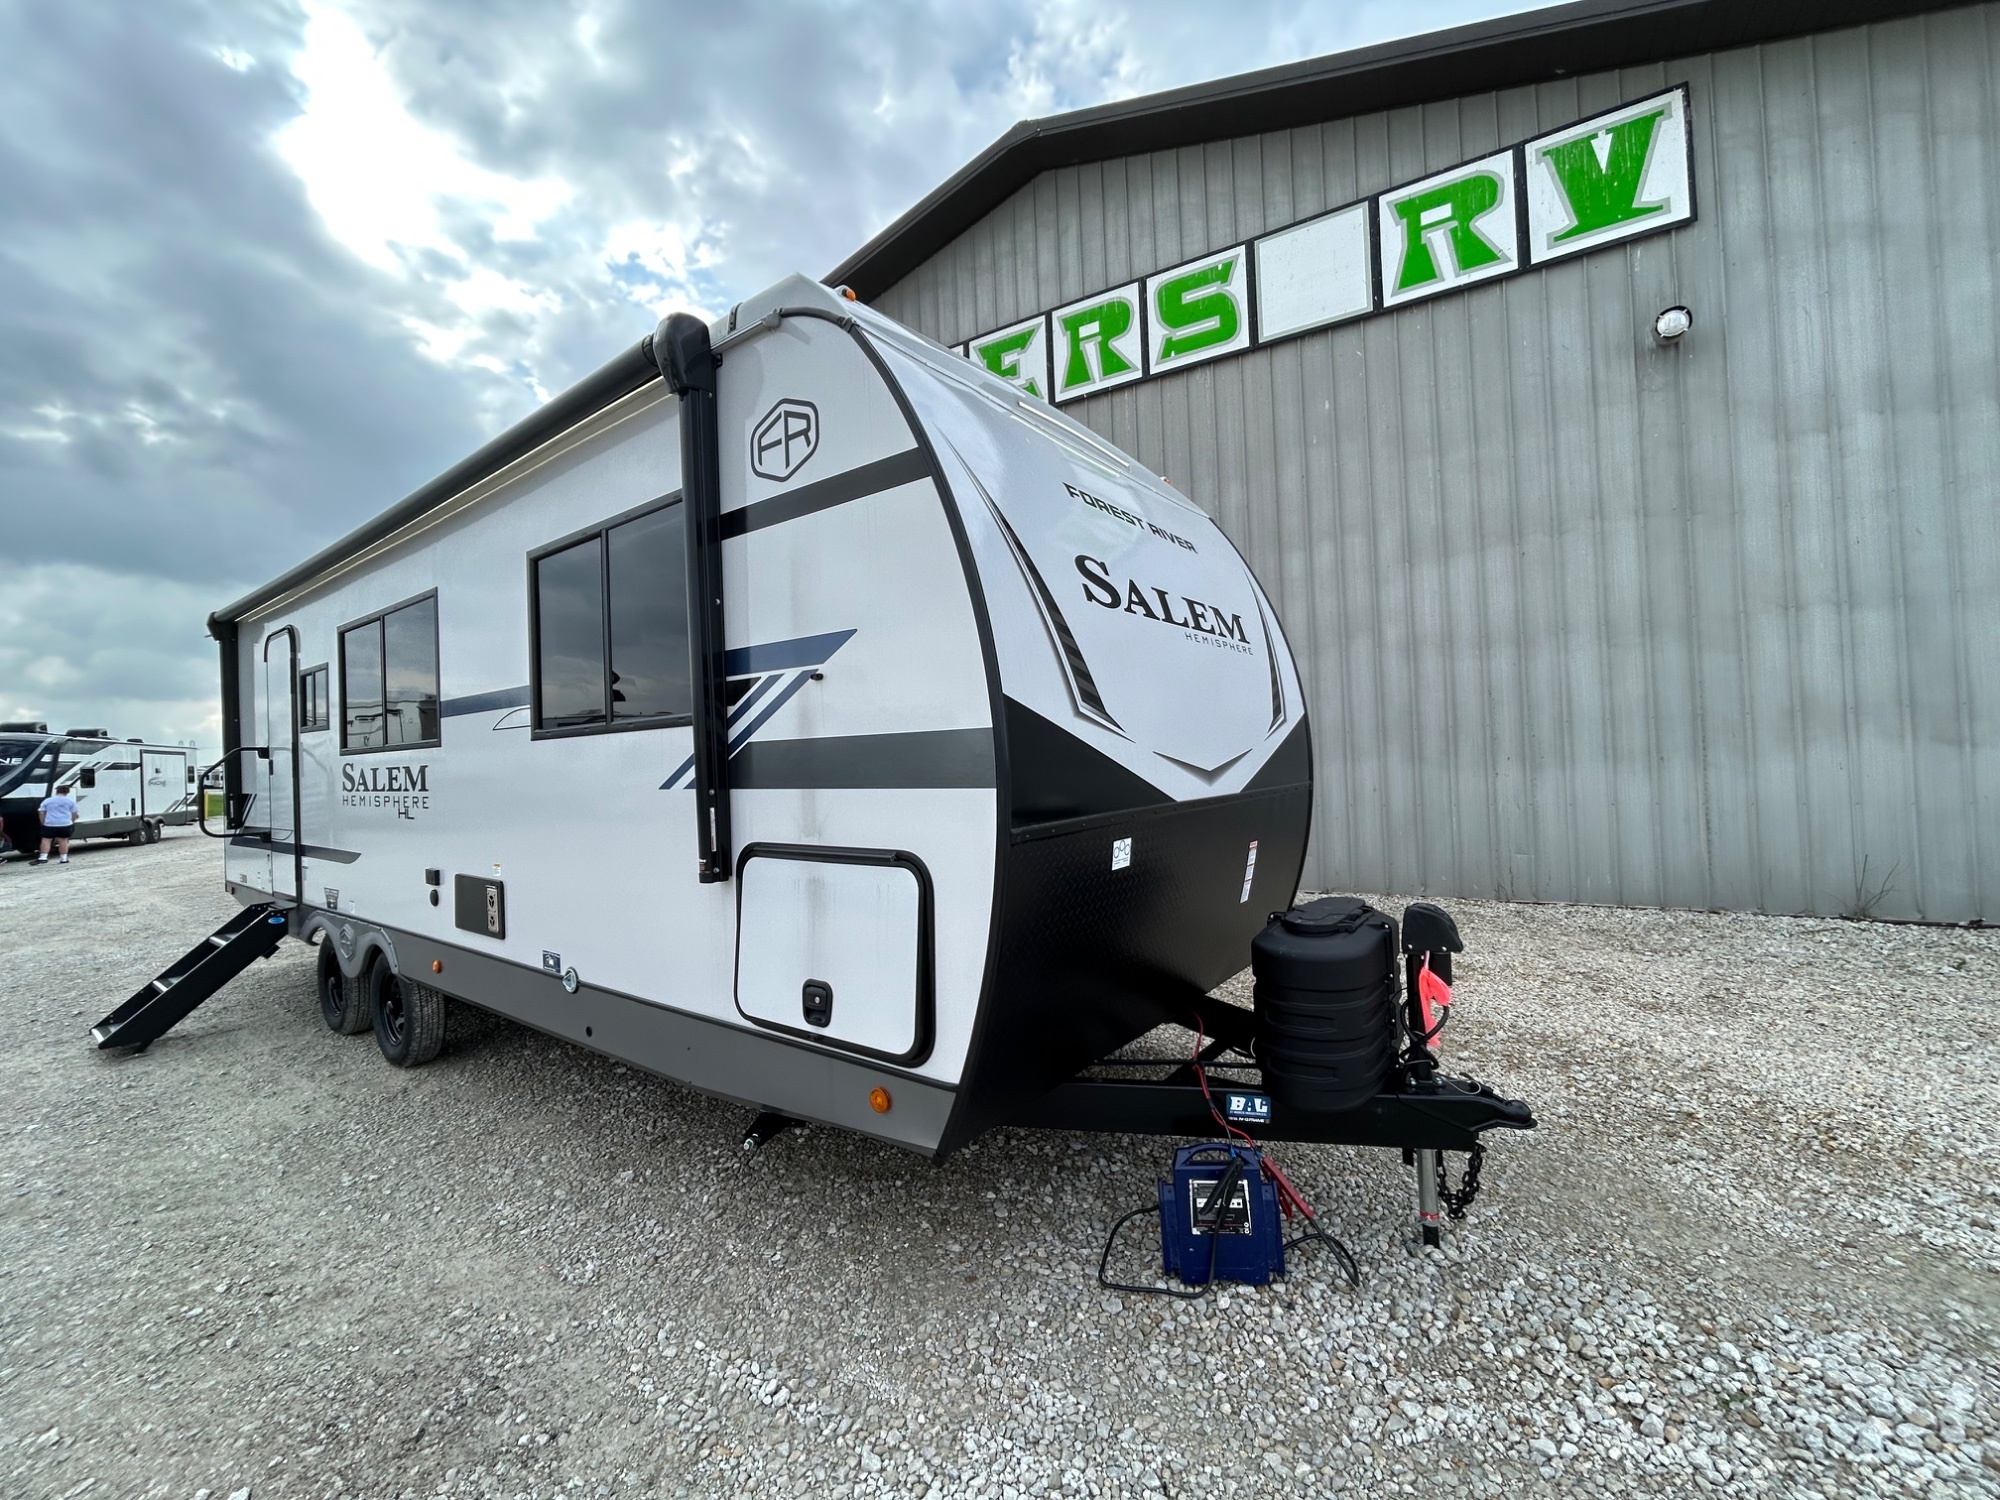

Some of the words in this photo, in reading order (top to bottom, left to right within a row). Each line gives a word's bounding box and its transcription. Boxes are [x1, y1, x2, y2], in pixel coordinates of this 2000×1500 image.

[1390, 101, 1673, 294] RV
[1061, 481, 1146, 531] FOREST
[1146, 521, 1199, 555] RIVER
[1074, 554, 1251, 645] SALEM
[1185, 631, 1254, 656] HEMISPHERE
[342, 762, 430, 793] SALEM
[342, 795, 430, 809] HEMISPHERE
[397, 808, 415, 820] HL
[1230, 1096, 1268, 1113] BAL
